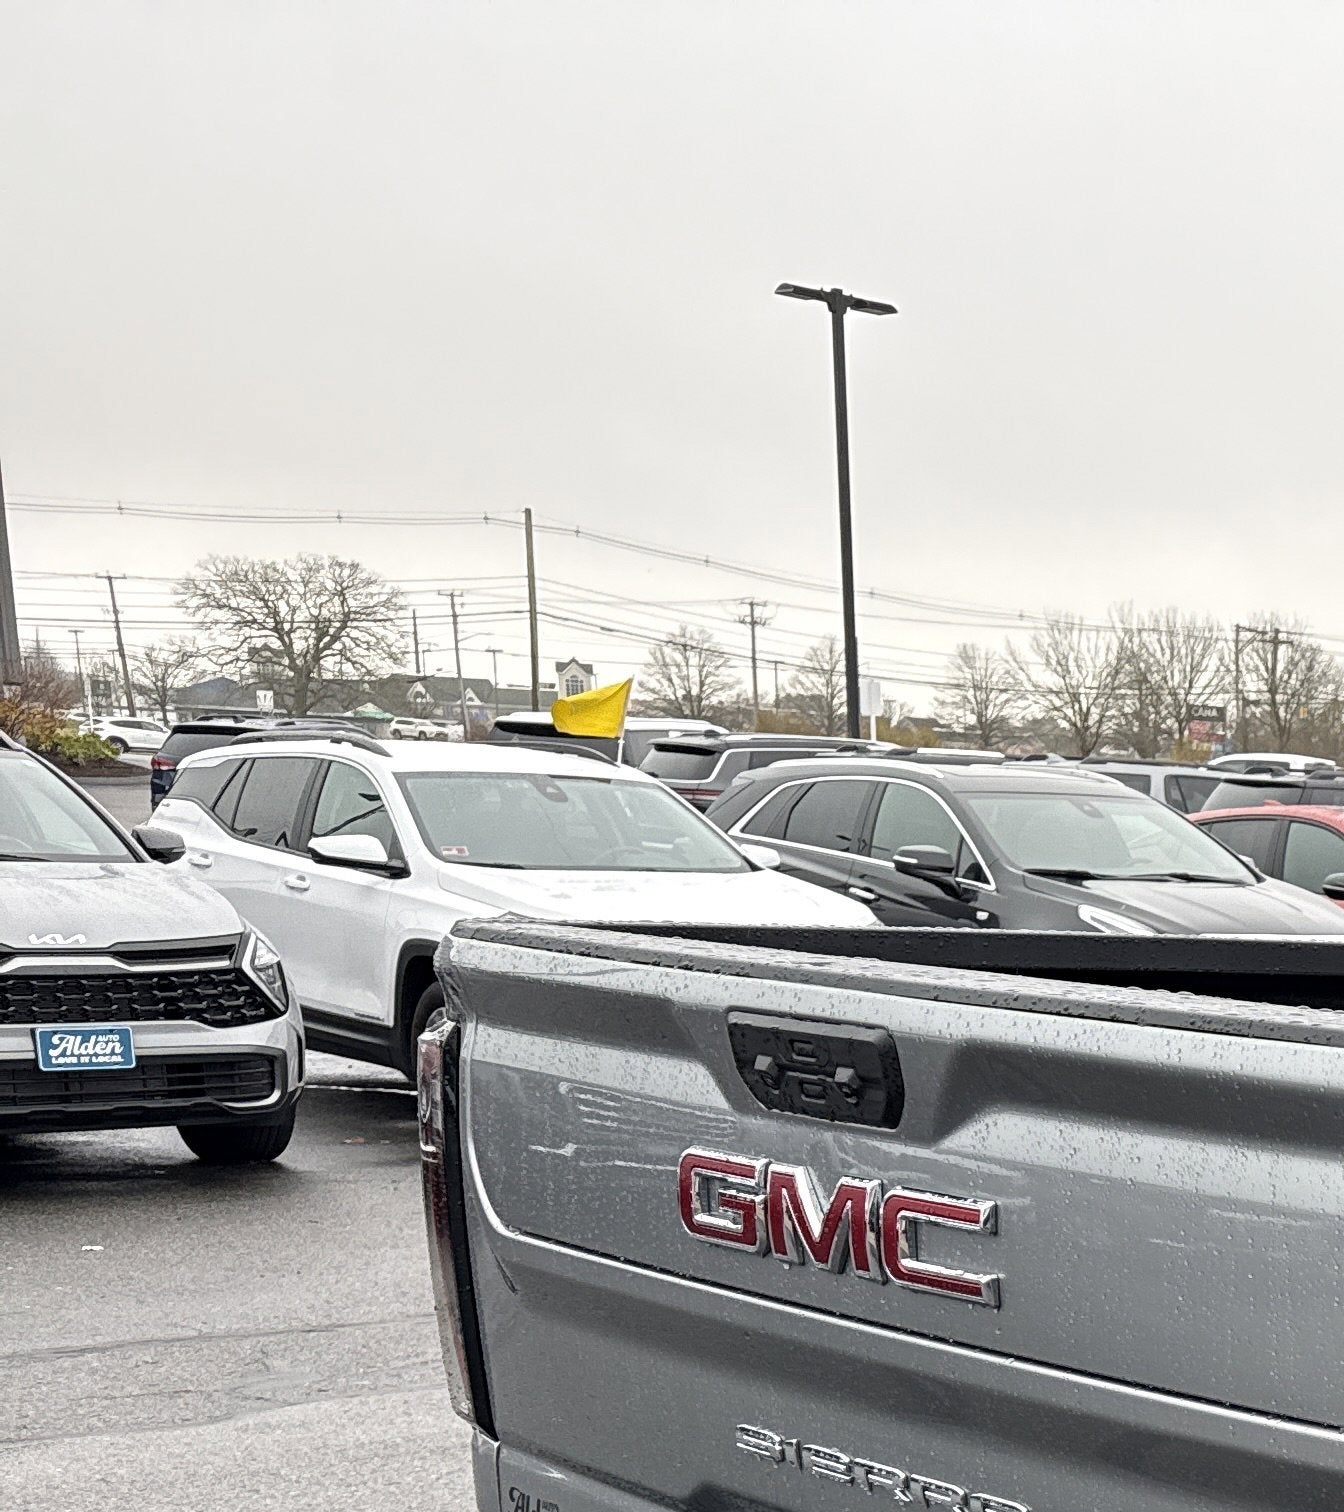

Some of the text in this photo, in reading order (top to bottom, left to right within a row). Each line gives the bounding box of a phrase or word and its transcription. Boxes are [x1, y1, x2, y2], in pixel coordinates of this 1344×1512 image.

[48, 1033, 125, 1057] Alden
[97, 1034, 120, 1042] AUTO
[51, 1056, 78, 1064] LOVE
[92, 1055, 125, 1063] LOCAL
[678, 1145, 1004, 1311] GMC
